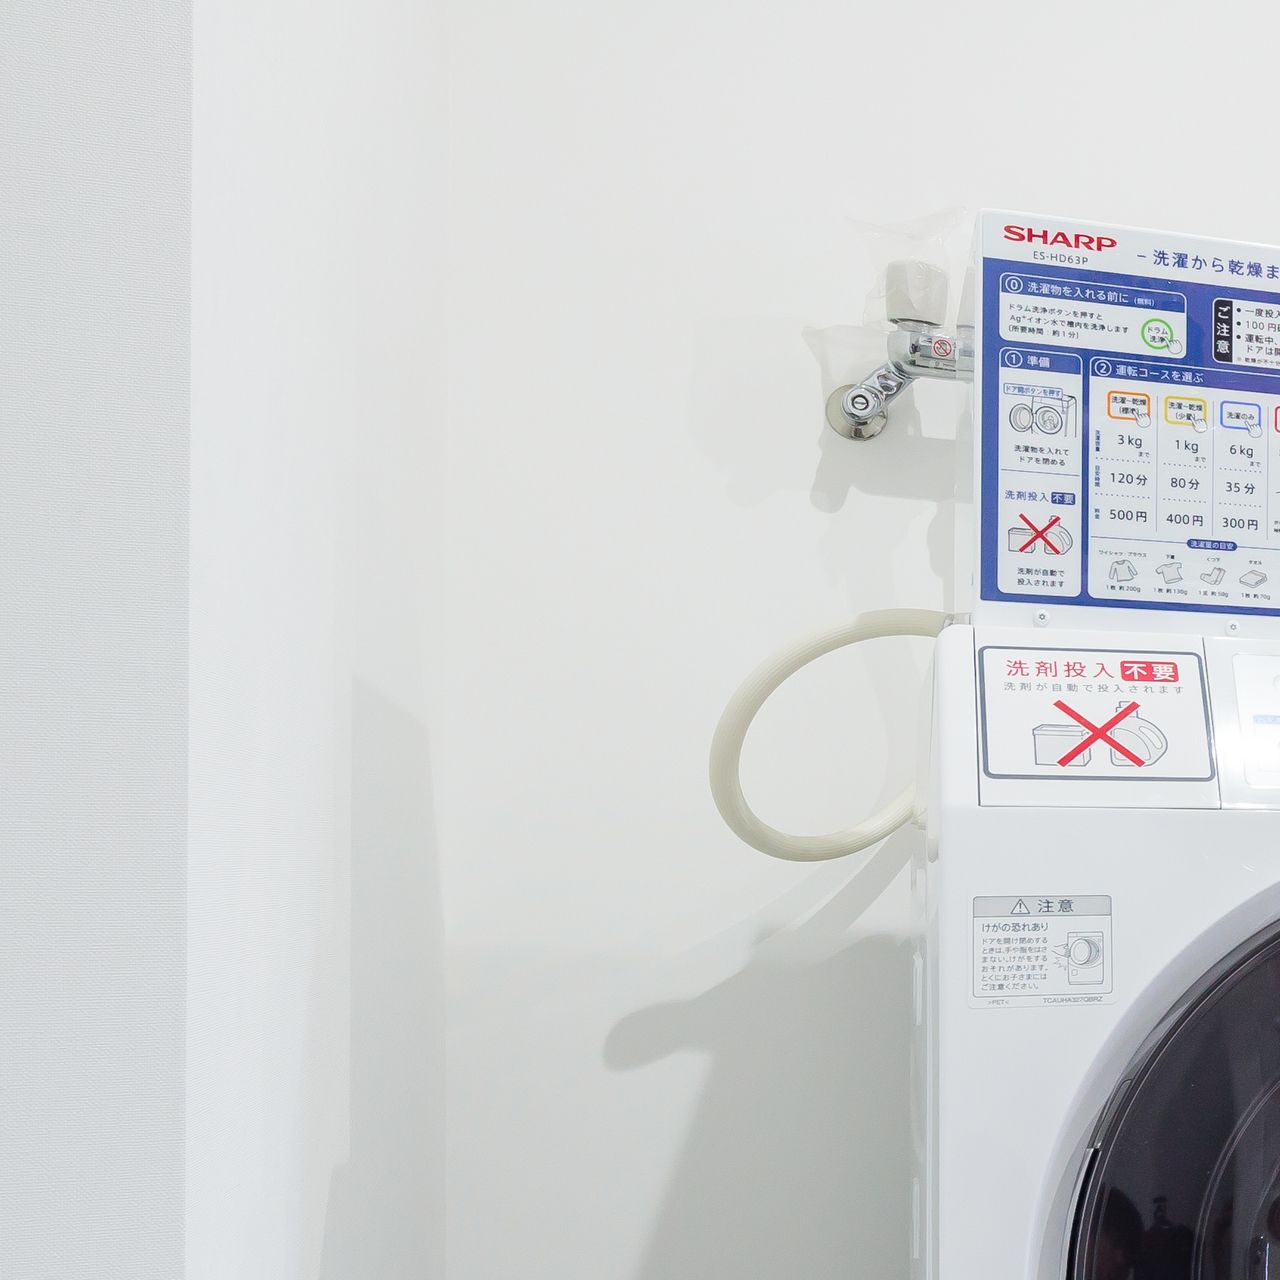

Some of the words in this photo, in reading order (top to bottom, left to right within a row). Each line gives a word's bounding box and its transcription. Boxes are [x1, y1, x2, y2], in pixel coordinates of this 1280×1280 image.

[1004, 225, 1117, 251] SHARP
[1033, 251, 1088, 265] ES-HD63P
[1028, 282, 1129, 303] 洗濯物を入れる前に
[1216, 306, 1230, 353] ご注意
[1027, 355, 1050, 367] 準備
[1116, 365, 1204, 383] 運転コースを選ぶ
[1227, 412, 1254, 420] 洗濯のみ
[1014, 444, 1069, 456] 洗濯物を入れて
[1019, 456, 1065, 466] ドアを閉める
[1110, 473, 1147, 486] 120分
[1171, 478, 1199, 490] 80分
[1226, 482, 1255, 495] 35分
[1005, 490, 1049, 502] 洗剤投入
[1053, 493, 1074, 504] 不要
[1110, 509, 1147, 522] 500円
[1167, 515, 1203, 526] 400円
[1222, 518, 1258, 530] 300円
[1017, 568, 1064, 577] 洗剤が自動で
[1017, 579, 1064, 587] 投入されます
[1006, 660, 1114, 679] 洗剤投入
[1123, 664, 1175, 680] 不要
[1004, 682, 1184, 694] 洗剤が自動で投入されます
[1038, 899, 1074, 913] 注意
[982, 923, 1048, 932] けがの恐れあり
[981, 965, 1048, 973] おそれがあります。
[981, 974, 1047, 982] とくにお子さまには
[981, 983, 1038, 991] ご注意ください。
